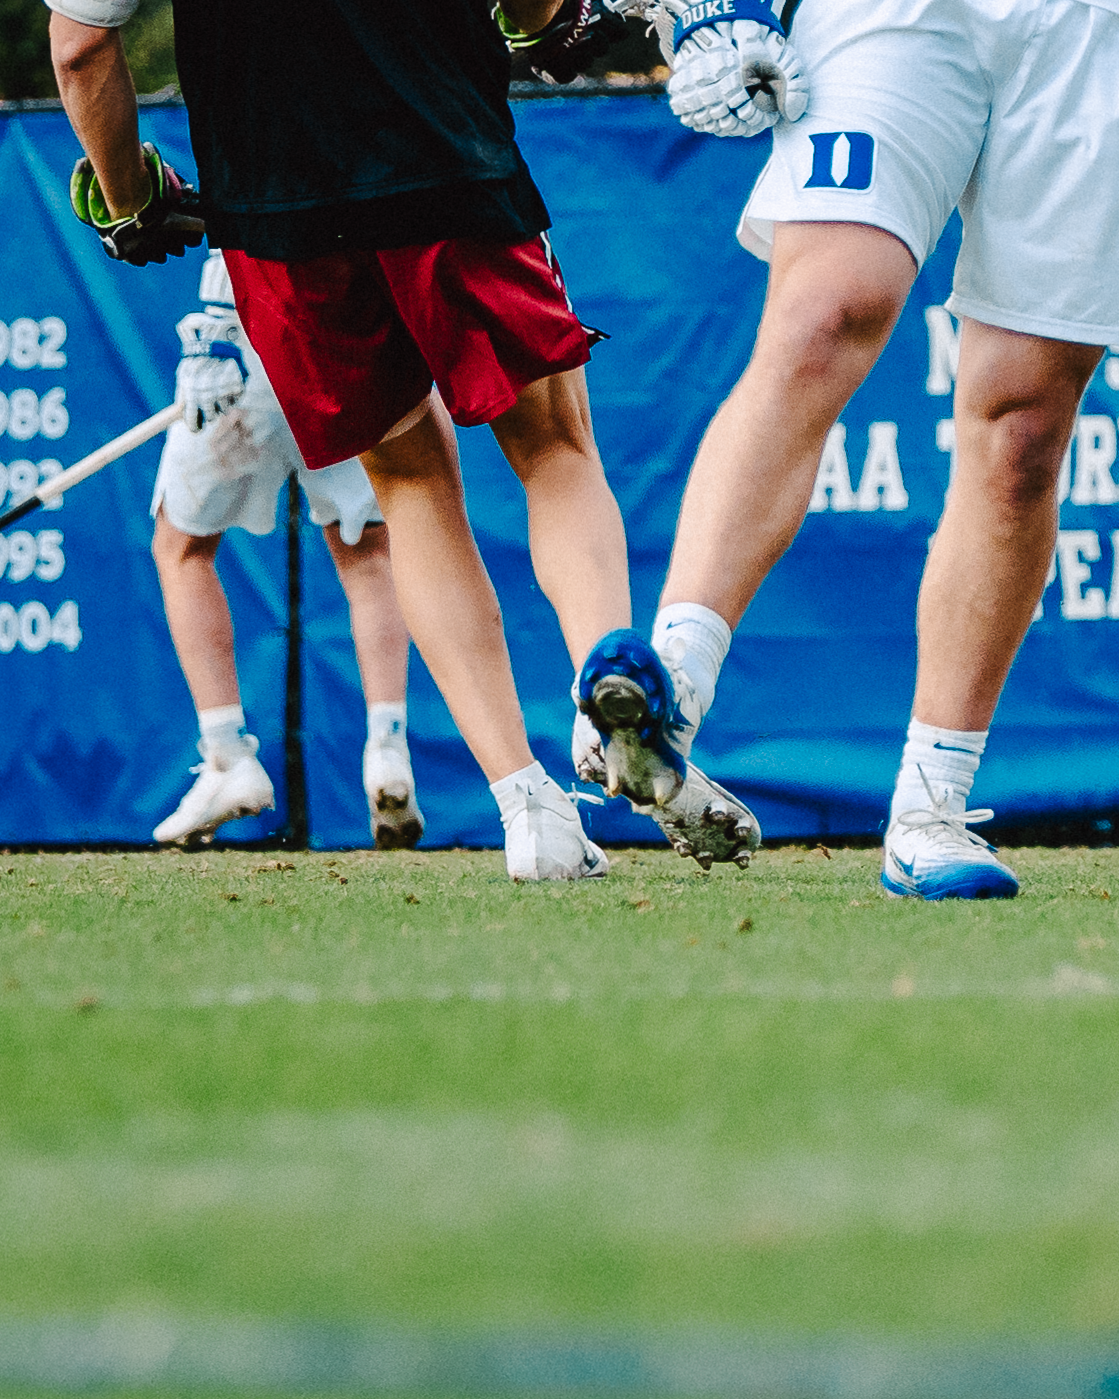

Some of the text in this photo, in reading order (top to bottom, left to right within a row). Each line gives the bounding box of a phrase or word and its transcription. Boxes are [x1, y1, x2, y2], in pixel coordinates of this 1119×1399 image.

[803, 131, 876, 191] D
[0, 317, 67, 368] 82
[0, 387, 70, 441] 86
[806, 421, 909, 513] AA
[0, 530, 66, 583] 95
[0, 600, 82, 652] 004
